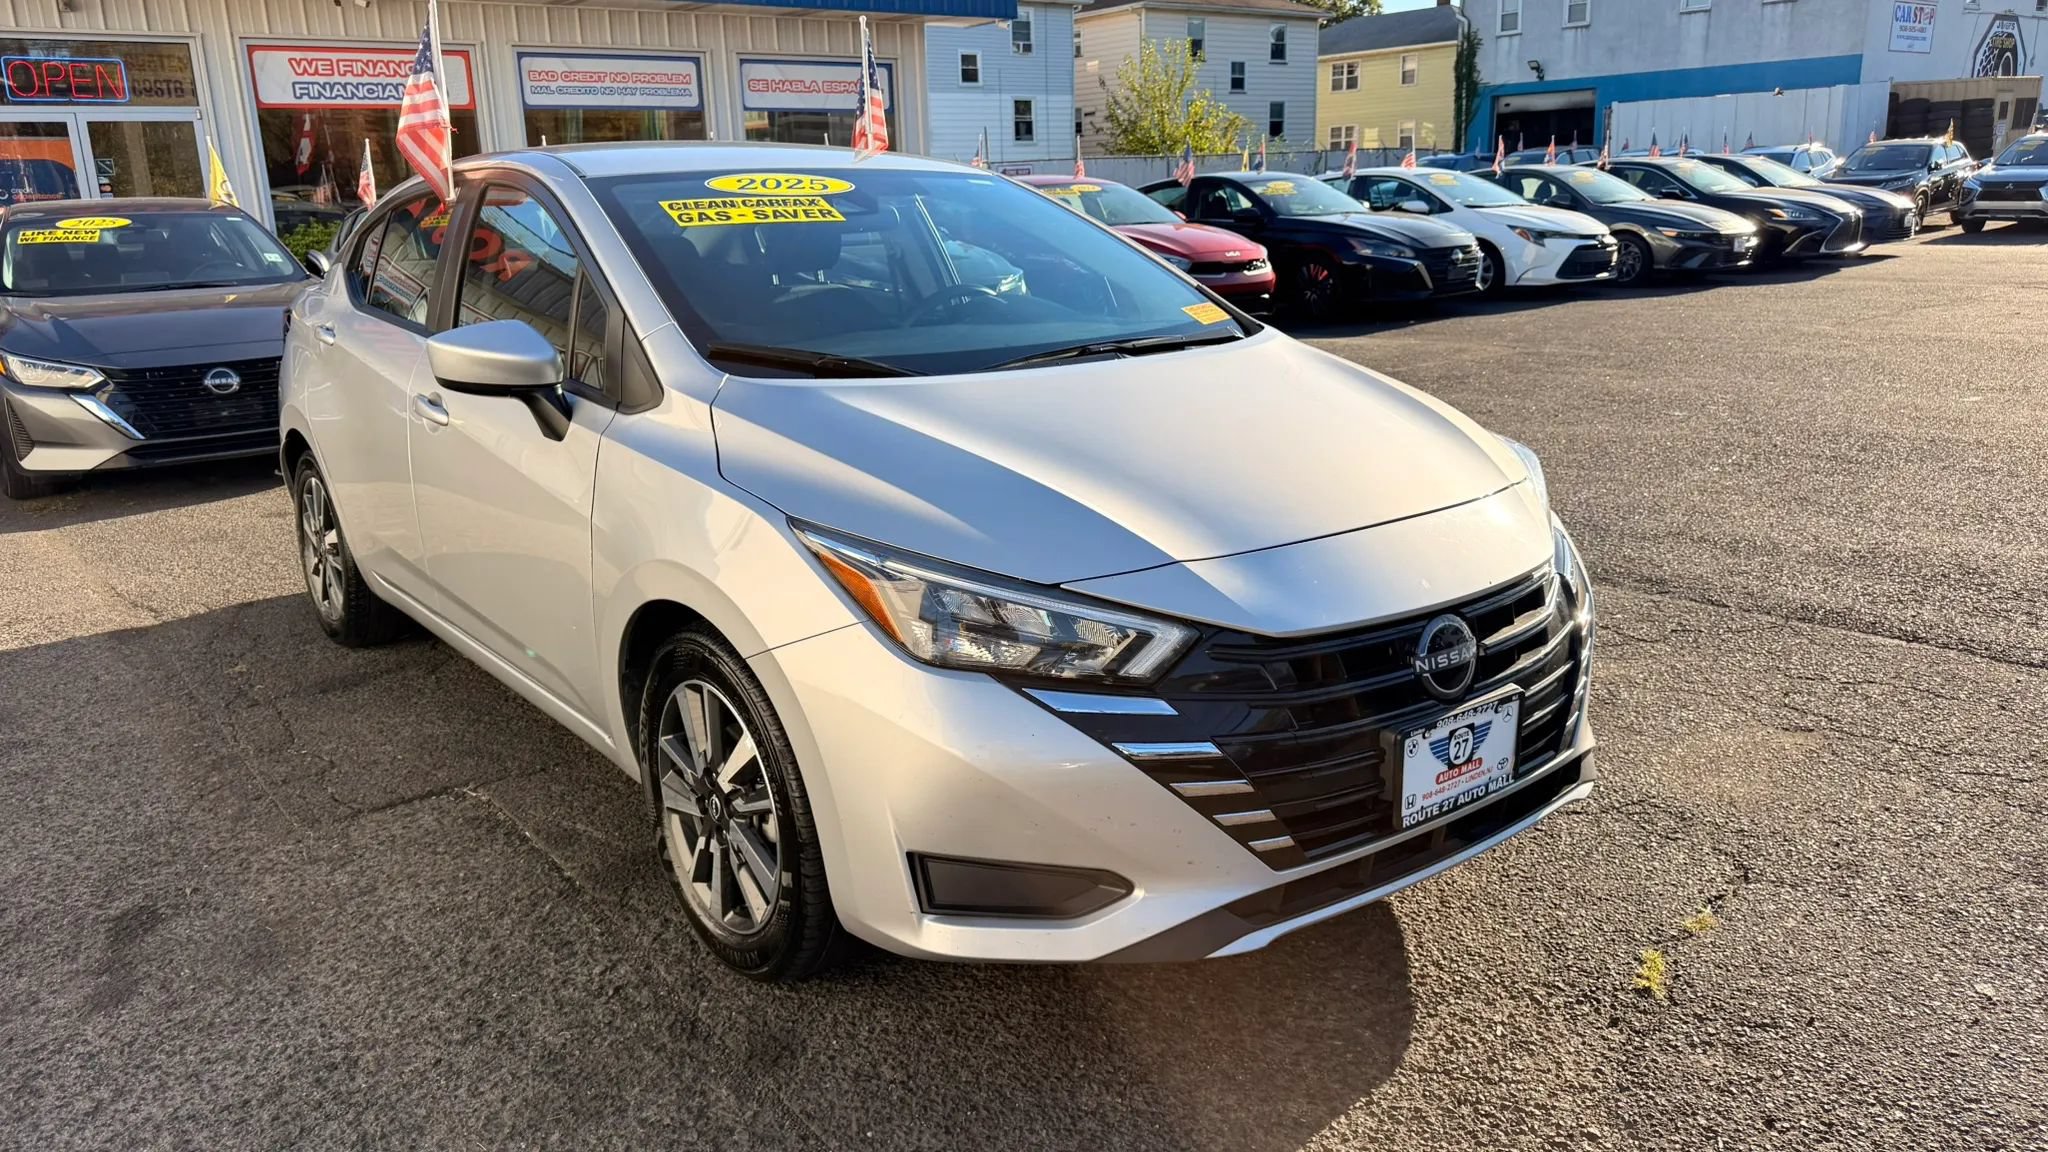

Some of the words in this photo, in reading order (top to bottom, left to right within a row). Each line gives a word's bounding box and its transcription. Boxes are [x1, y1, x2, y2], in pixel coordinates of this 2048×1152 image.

[1895, 5, 1911, 23] CAR
[288, 58, 334, 76] WE
[338, 59, 417, 77] FINANC
[8, 60, 124, 98] OPEN
[528, 70, 558, 82] BAD
[561, 71, 607, 83] CREDIT
[609, 72, 630, 83] NO
[632, 73, 691, 84] PROBLEM
[530, 86, 555, 95] MAL
[556, 86, 599, 95] CREDITO
[600, 87, 615, 96] NO
[617, 87, 638, 96] HAY
[639, 88, 692, 97] PROBLEMA
[748, 79, 769, 92] SE
[771, 79, 820, 93] HABLA
[736, 177, 829, 191] 2025
[667, 199, 736, 212] CLEAN
[741, 198, 819, 208] CARFAX
[72, 218, 119, 227] 2025
[677, 211, 732, 224] GAS
[753, 208, 838, 220] SAVER
[1436, 702, 1499, 728] 908-648-2727
[1453, 730, 1470, 740] ROUTE
[1453, 738, 1470, 760] 27
[1438, 768, 1459, 783] AUTO
[1461, 761, 1481, 775] MALL
[1422, 781, 1460, 800] 908-648-2727
[1403, 804, 1440, 828] ROUTE
[1442, 798, 1455, 811] 27
[1457, 786, 1486, 806] AUTO
[1488, 774, 1514, 792] MALL
